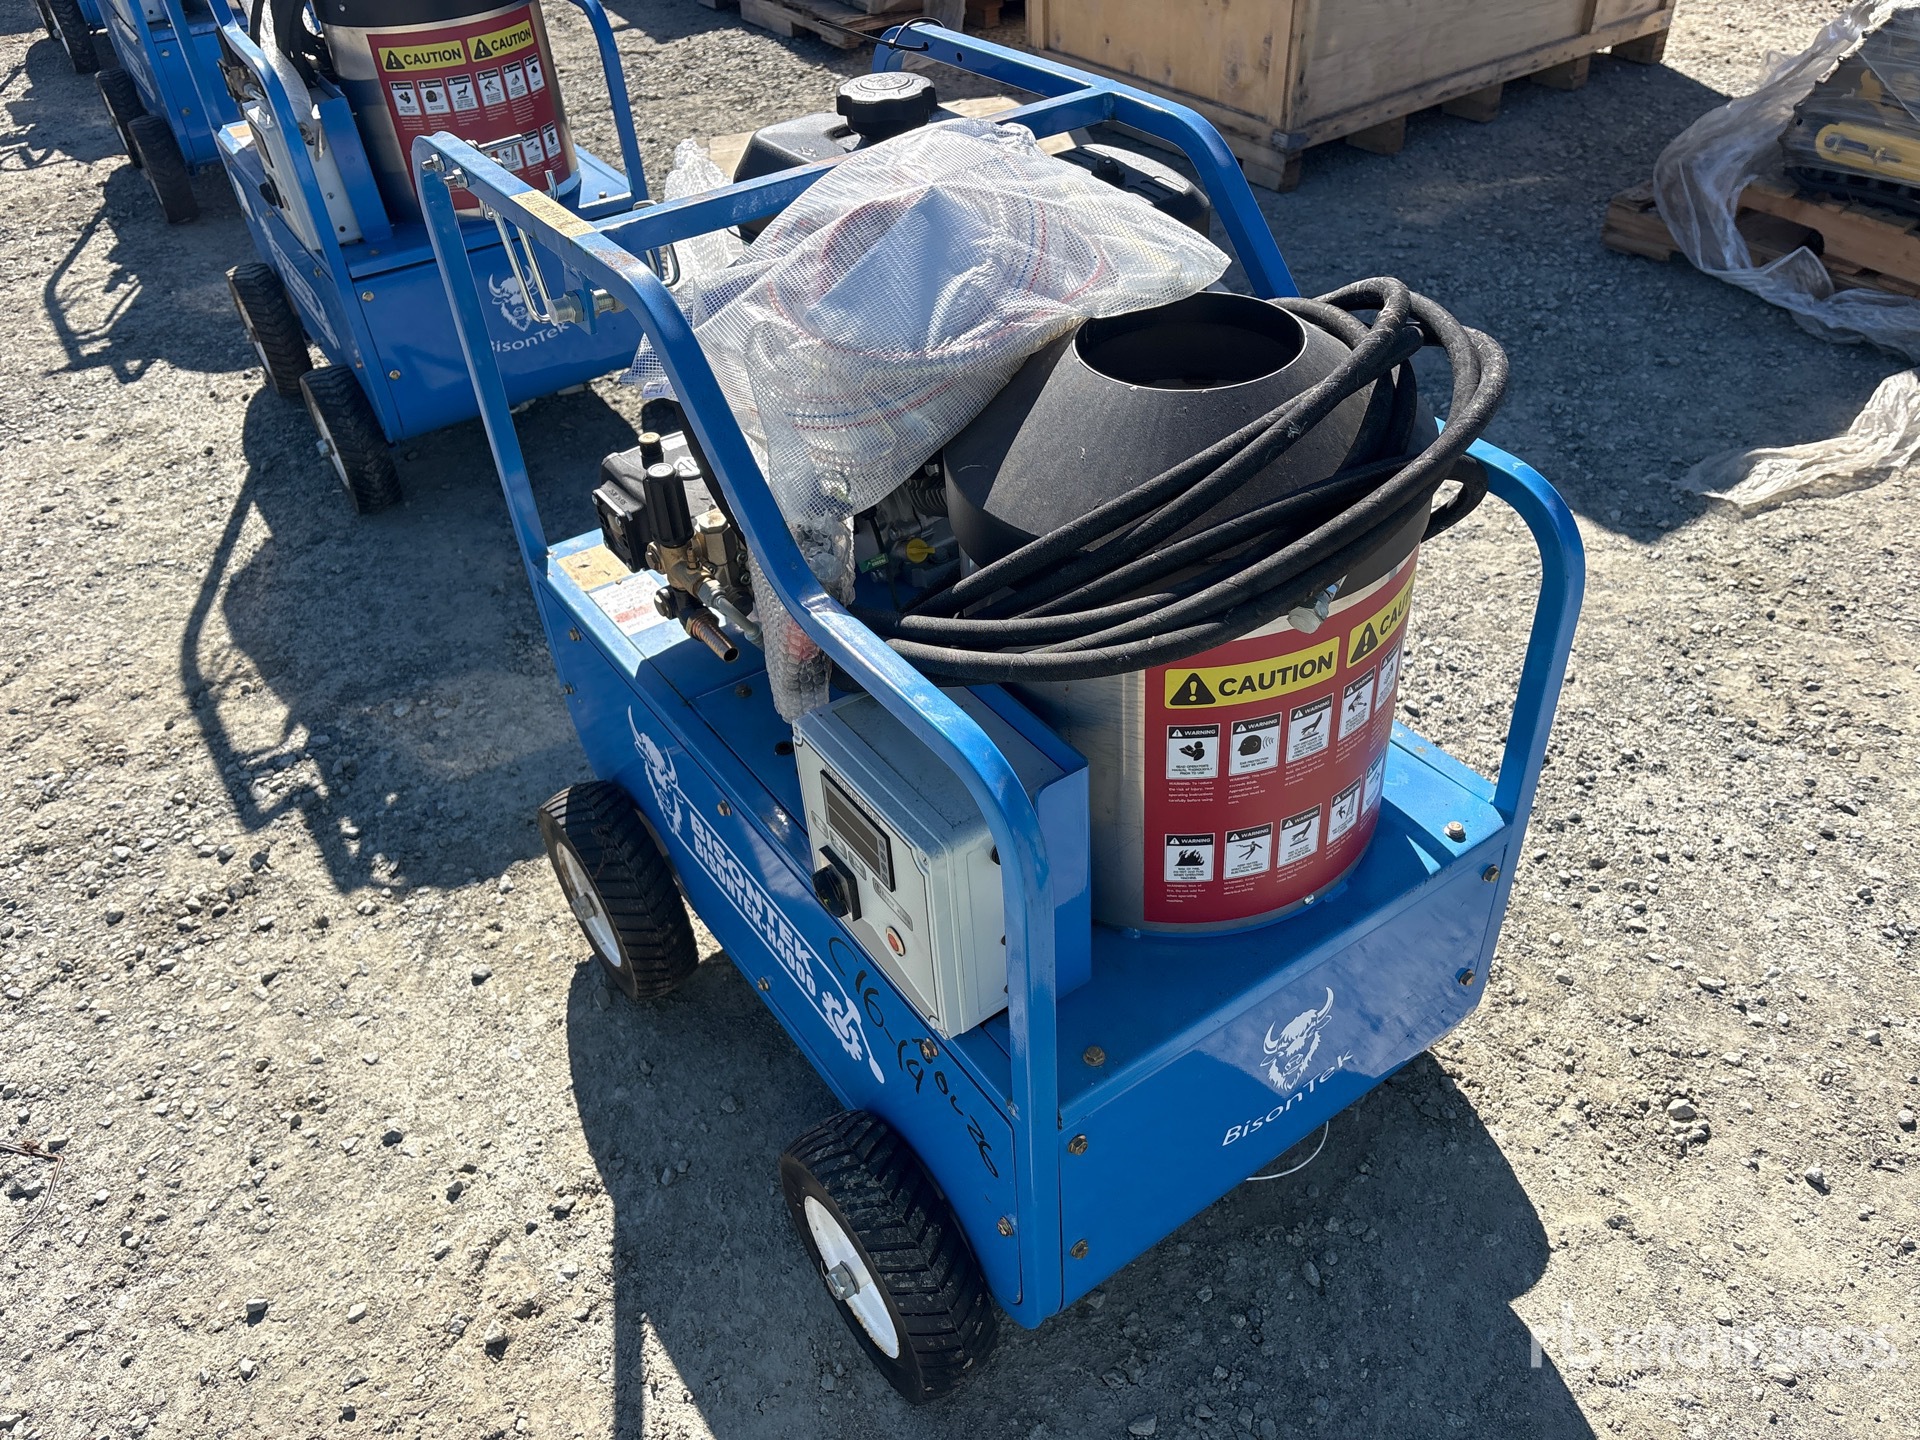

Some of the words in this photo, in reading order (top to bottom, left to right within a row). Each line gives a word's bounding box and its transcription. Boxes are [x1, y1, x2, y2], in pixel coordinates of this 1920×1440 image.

[404, 47, 462, 66] CAUTION
[491, 27, 532, 52] CAUTION
[1380, 586, 1411, 636] CAUT
[1218, 650, 1334, 698] CAUTION
[1248, 718, 1278, 730] WARNING
[1304, 700, 1330, 714] WARNING
[1241, 828, 1269, 838] WARNING
[690, 810, 812, 975] BISONTEK
[694, 834, 816, 998] BISONTEK-H4000
[1222, 1050, 1354, 1146] BisonTek
